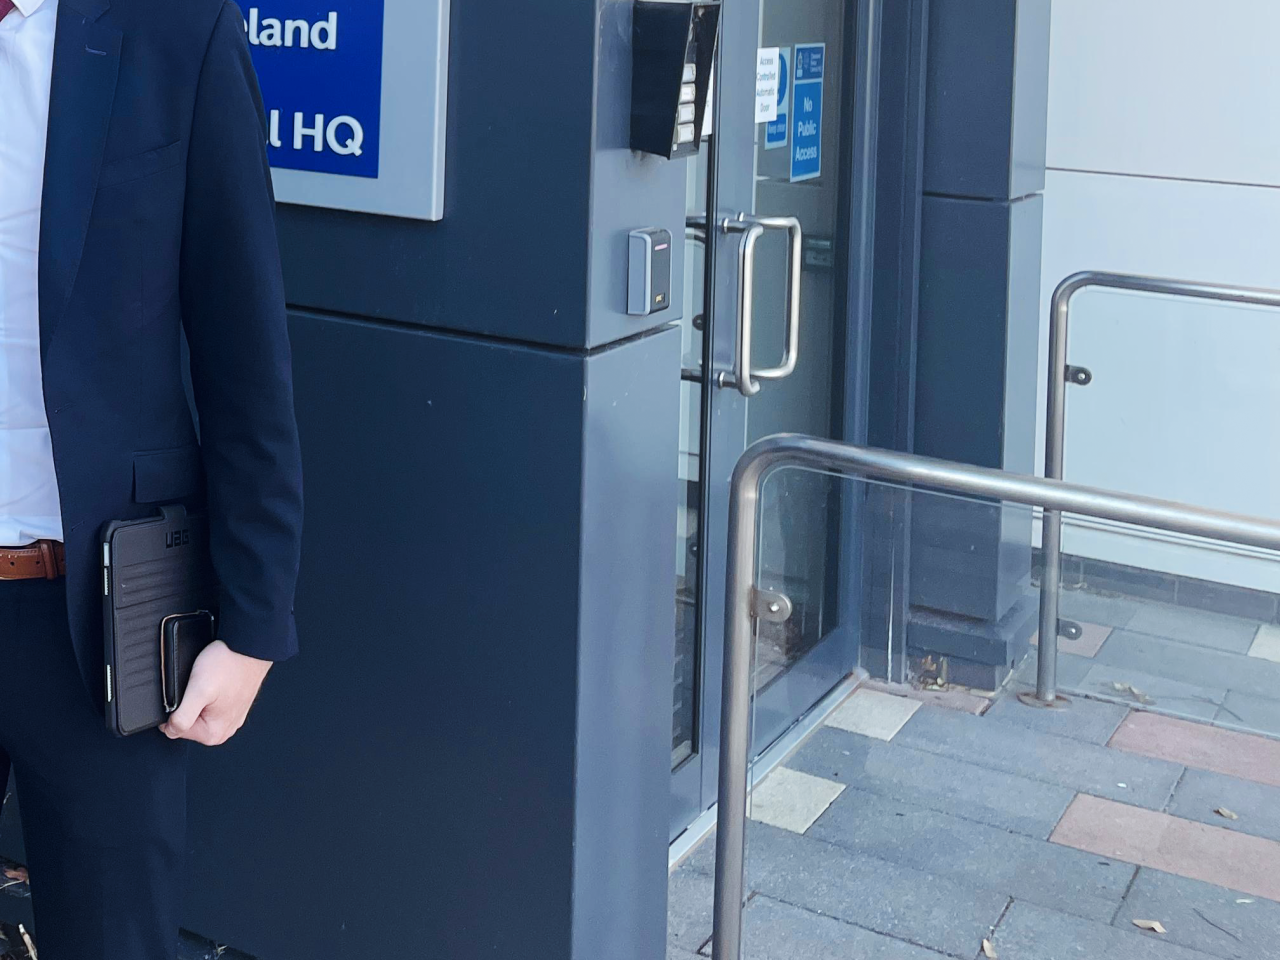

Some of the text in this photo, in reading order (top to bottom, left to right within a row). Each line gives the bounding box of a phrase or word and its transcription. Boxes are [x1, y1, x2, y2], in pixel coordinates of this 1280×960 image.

[244, 7, 337, 49] land
[804, 97, 812, 113] No
[293, 112, 363, 156] HQ
[798, 122, 816, 137] Public
[795, 146, 817, 162] Access
